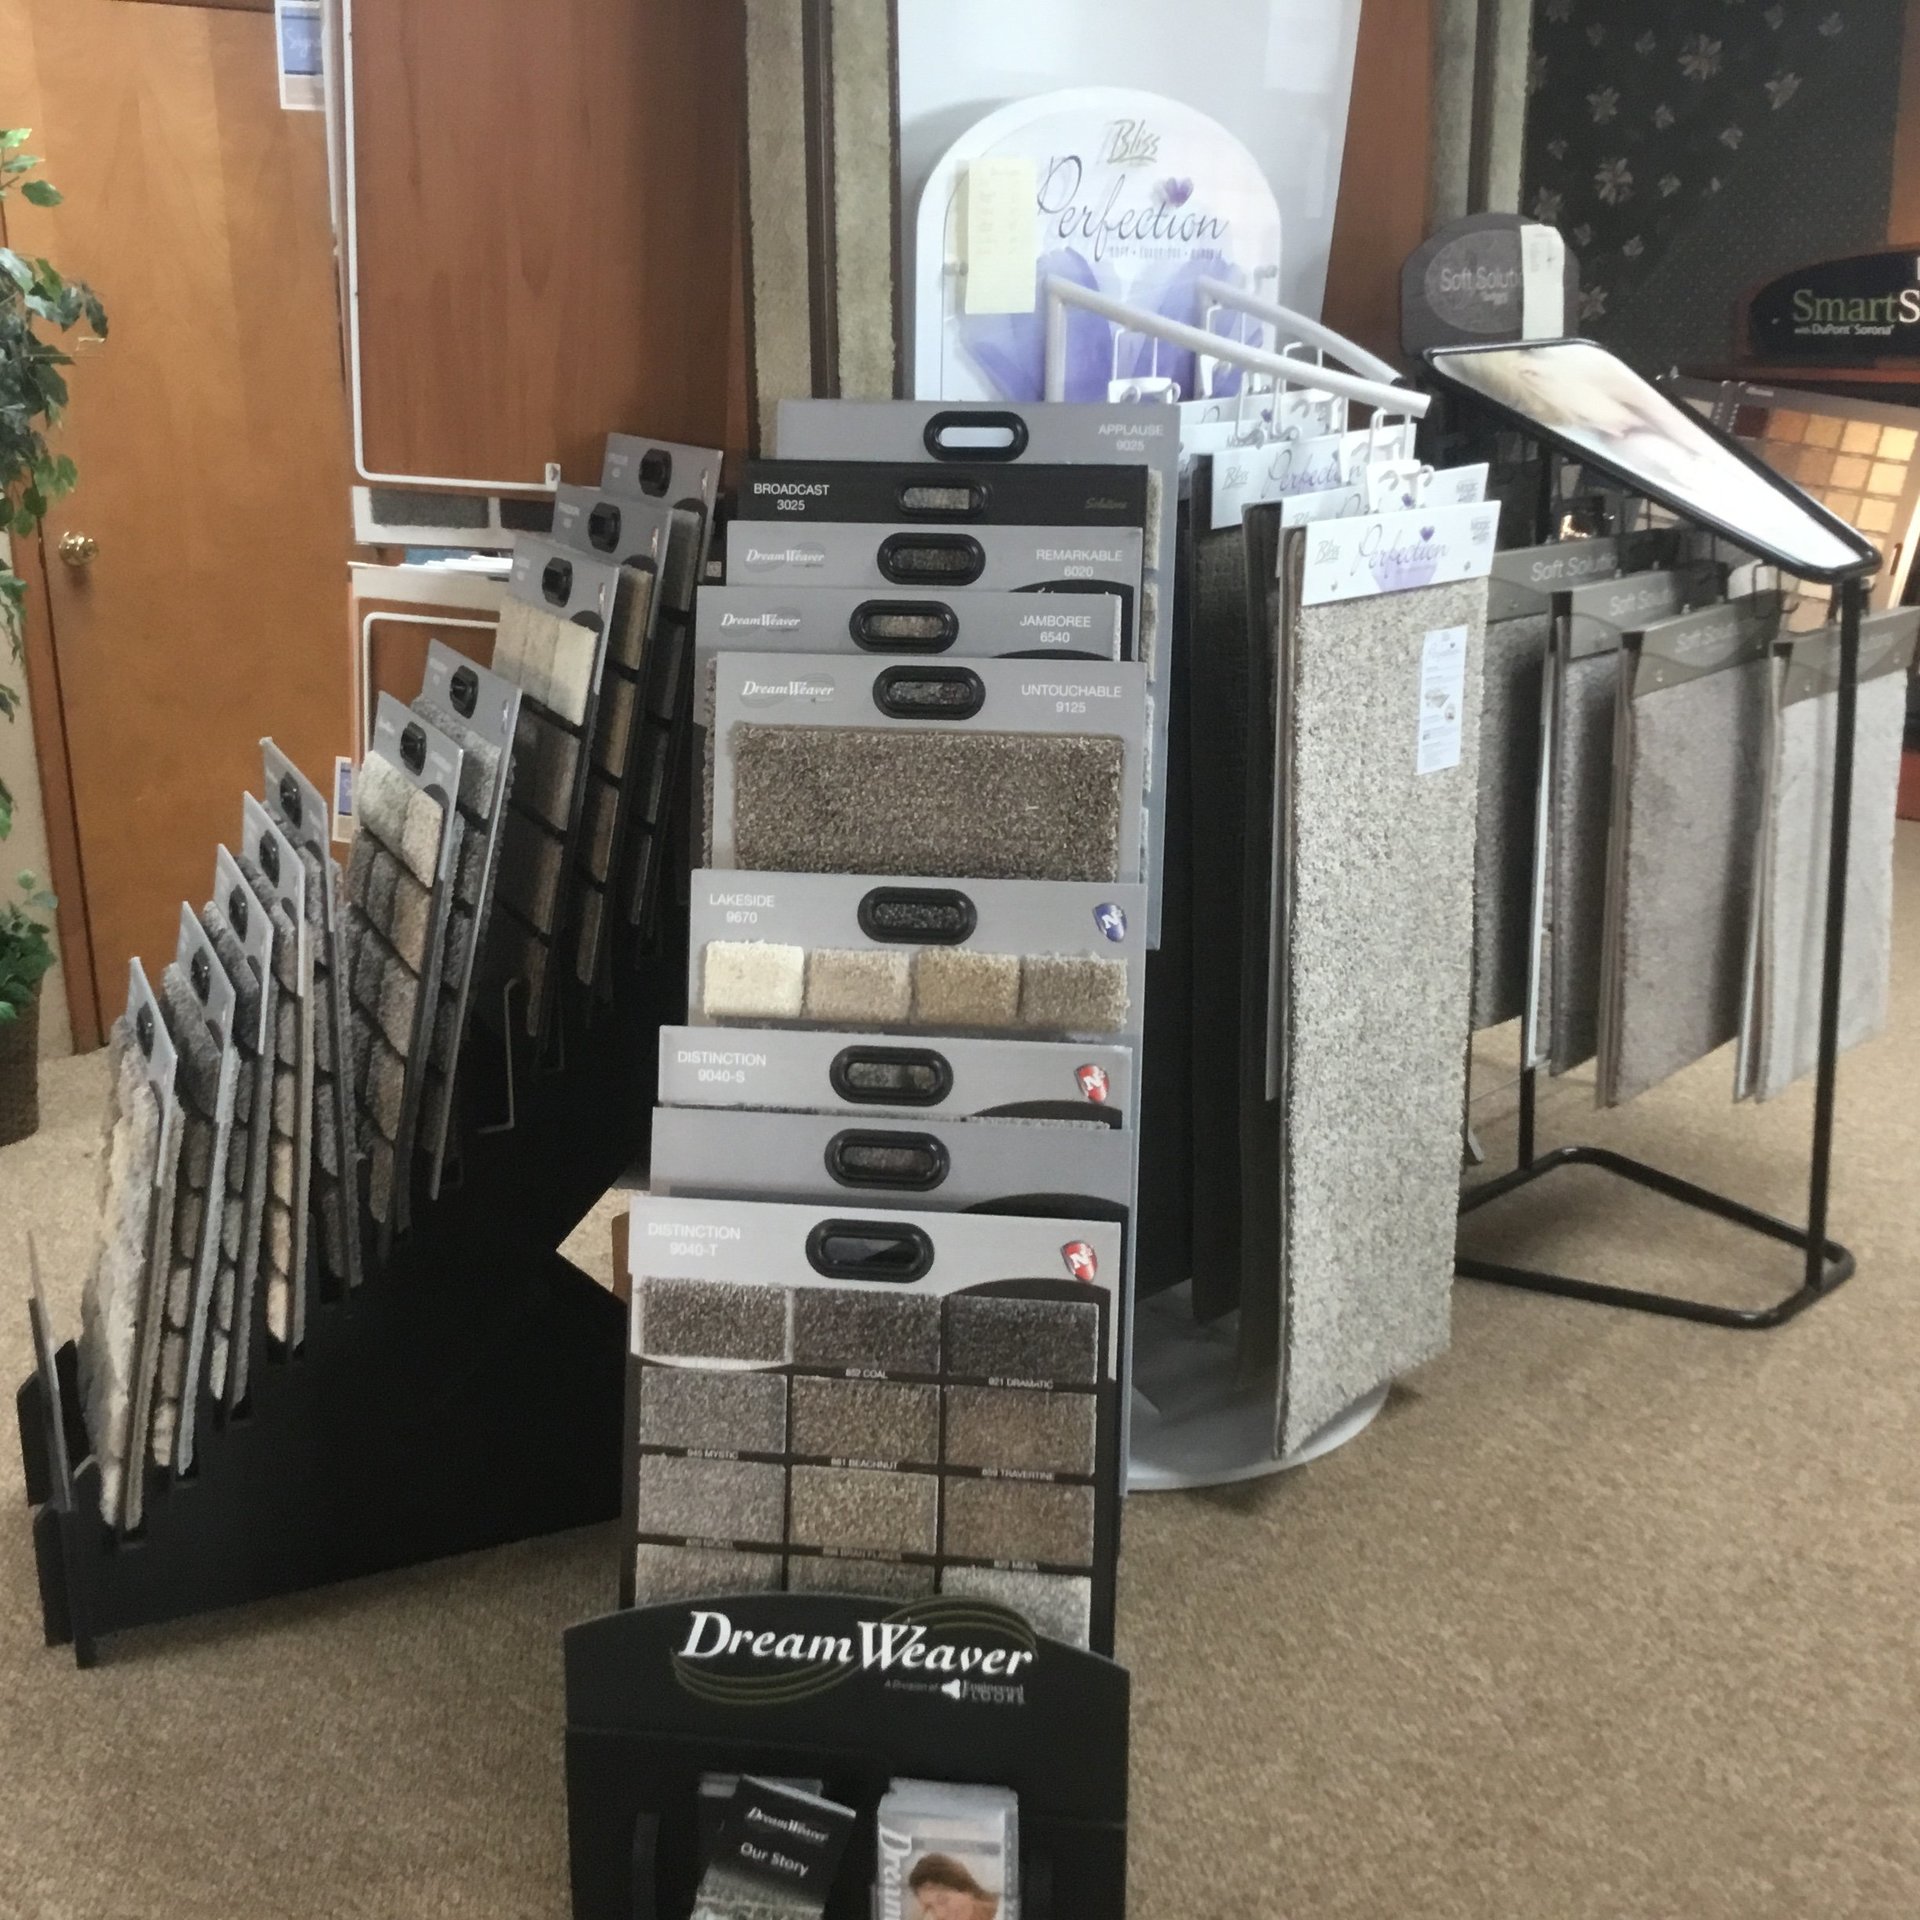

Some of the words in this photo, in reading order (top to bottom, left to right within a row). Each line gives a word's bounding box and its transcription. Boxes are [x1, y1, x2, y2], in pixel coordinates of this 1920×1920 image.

[1106, 118, 1161, 164] Bliss
[1036, 154, 1230, 263] Perfection
[1812, 323, 1850, 335] DuPont
[1098, 423, 1164, 436] APPLAUSE
[753, 483, 830, 496] BROADCAST
[776, 499, 806, 511] 3025
[1035, 549, 1123, 562] REMARKABLE
[1350, 523, 1449, 579] Perfection
[1063, 566, 1094, 577] 6020
[1530, 561, 1563, 582] Soft
[720, 613, 801, 628] DreamWeaver
[1019, 615, 1092, 628] JAMBOREE
[1040, 632, 1071, 643] 6540
[741, 680, 835, 697] DreamWeaver
[1021, 684, 1122, 698] UNTOUCHABLE
[1055, 701, 1086, 713] 9125
[709, 894, 775, 907] LAKESIDE
[726, 911, 758, 924] 9670
[677, 1051, 767, 1066] DISTINCTION
[697, 1069, 745, 1083] 9040-S
[647, 1222, 741, 1240] DISTINCTION
[670, 1242, 718, 1257] 9040-T
[863, 1369, 888, 1379] COAL
[1006, 1378, 1053, 1389] DRAMATIC
[704, 1450, 739, 1460] MYSTIC
[1000, 1470, 1055, 1481] TRAVERTINE
[678, 1610, 1033, 1676] DreamWeaver
[740, 1842, 769, 1862] Our
[770, 1852, 809, 1877] Story
